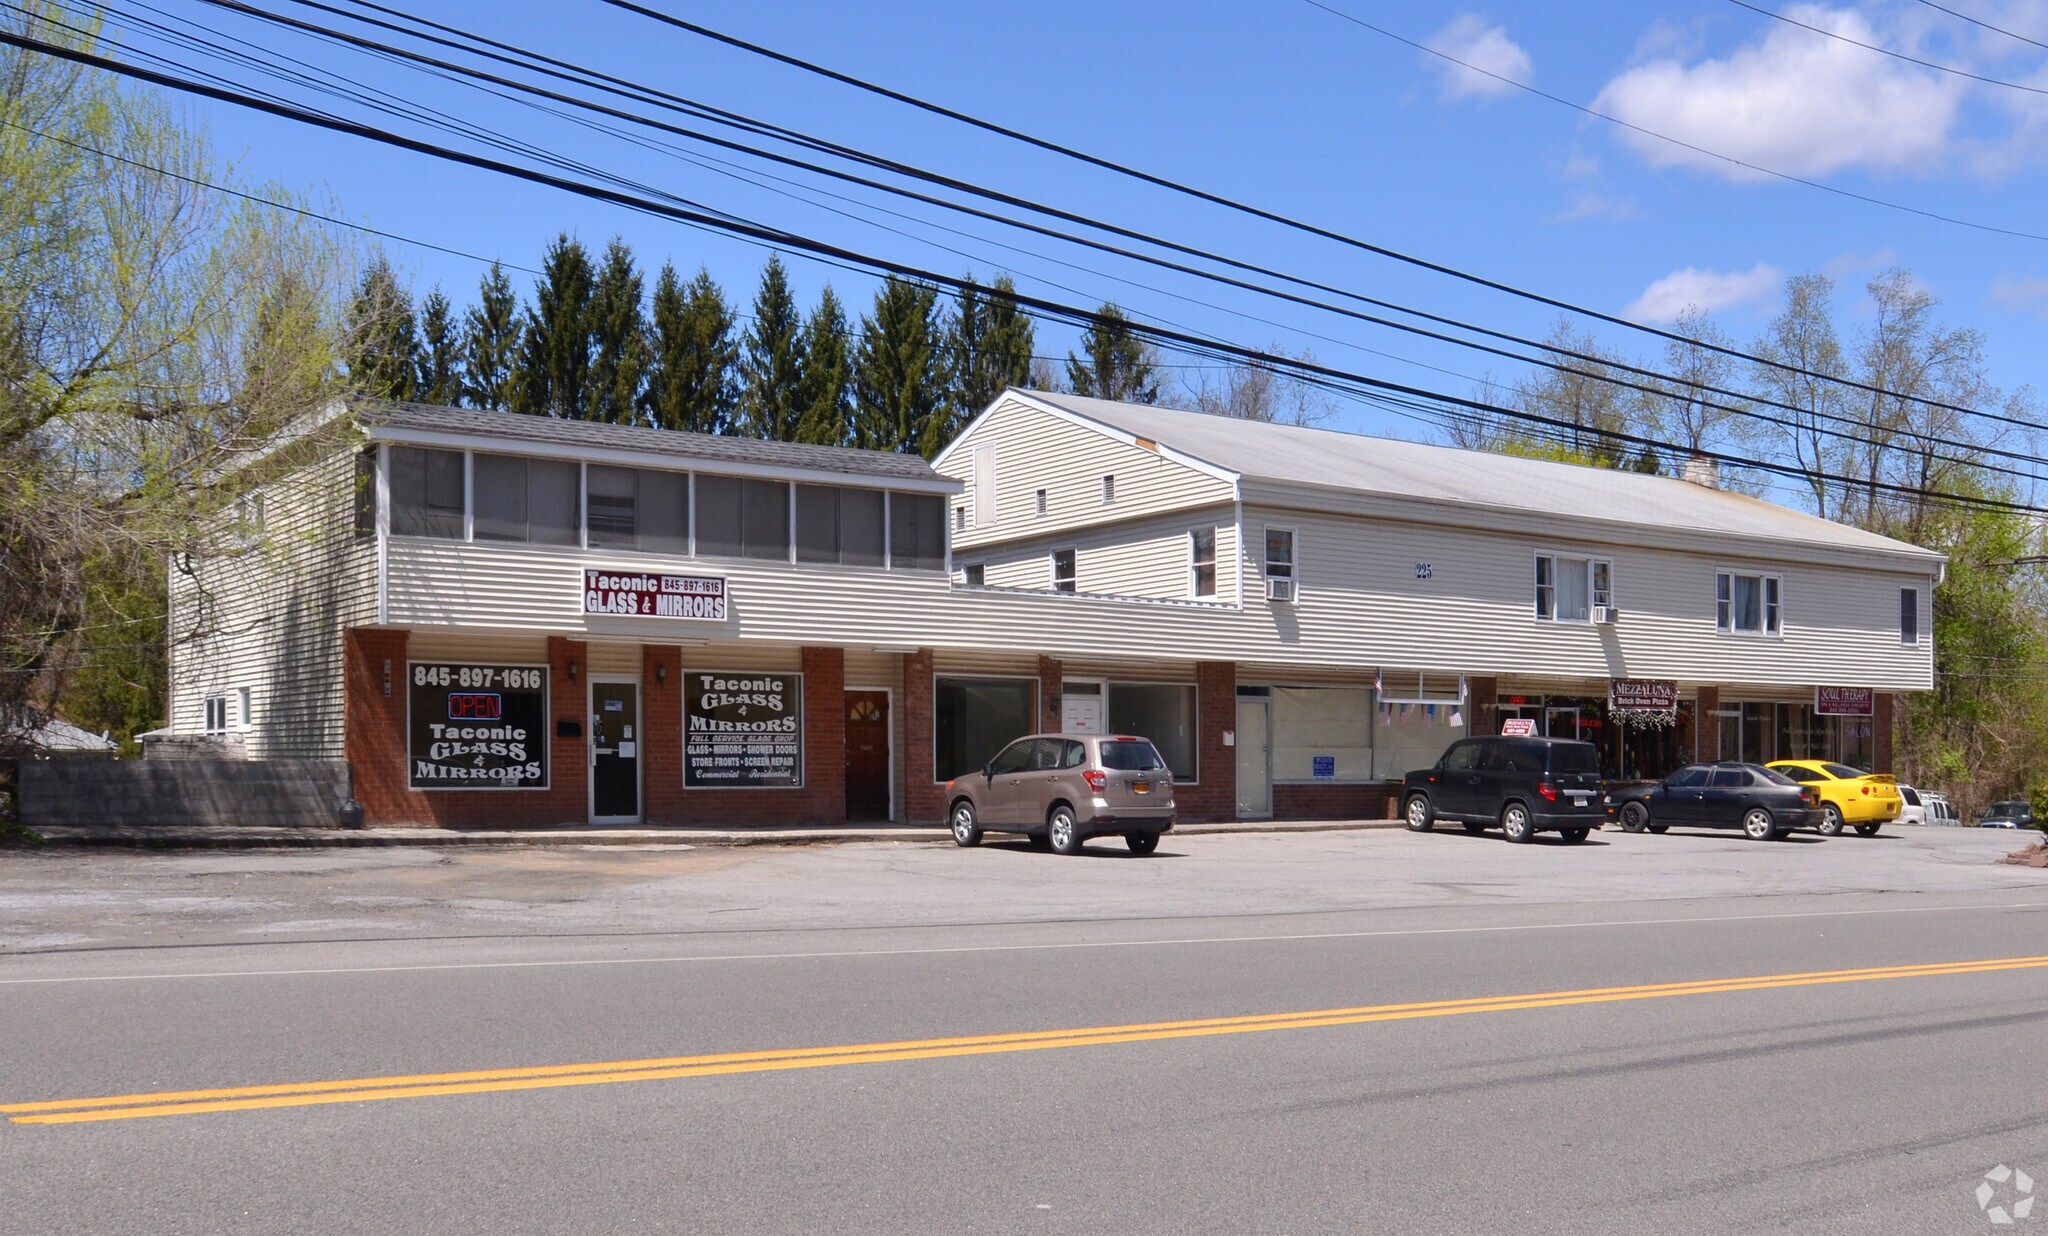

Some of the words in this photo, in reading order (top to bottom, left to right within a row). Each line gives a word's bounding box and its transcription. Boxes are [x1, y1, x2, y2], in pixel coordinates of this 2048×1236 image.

[1417, 563, 1431, 579] 225
[587, 571, 658, 592] Taconic
[664, 579, 719, 592] 845-897-1616
[586, 590, 638, 614] GLASS
[643, 596, 651, 613] &
[656, 594, 724, 618] MIRRORS
[415, 666, 541, 689] 845-897-1616
[701, 676, 783, 691] Taconic
[1616, 683, 1674, 697] MEZZALUNA
[1821, 687, 1840, 699] SOUL
[1841, 688, 1870, 701] THERAPY
[451, 696, 500, 717] OPEN
[701, 693, 783, 712] GLASS
[1618, 697, 1634, 705] Brick
[738, 705, 748, 716] &
[689, 715, 796, 732] MIRRORS
[1846, 725, 1871, 737] SALON
[430, 724, 526, 740] Taconic
[430, 742, 527, 761] GLASS
[687, 745, 709, 754] GLASS
[714, 746, 742, 754] MIRRORS
[747, 745, 773, 754] SHOWER
[776, 746, 797, 754] DOORS
[473, 755, 485, 767] &
[745, 757, 770, 767] SCREEN
[771, 757, 794, 767] REPAIR
[415, 761, 541, 779] MIRRORS
[695, 769, 740, 779] Commercial
[749, 769, 791, 778] Residential
